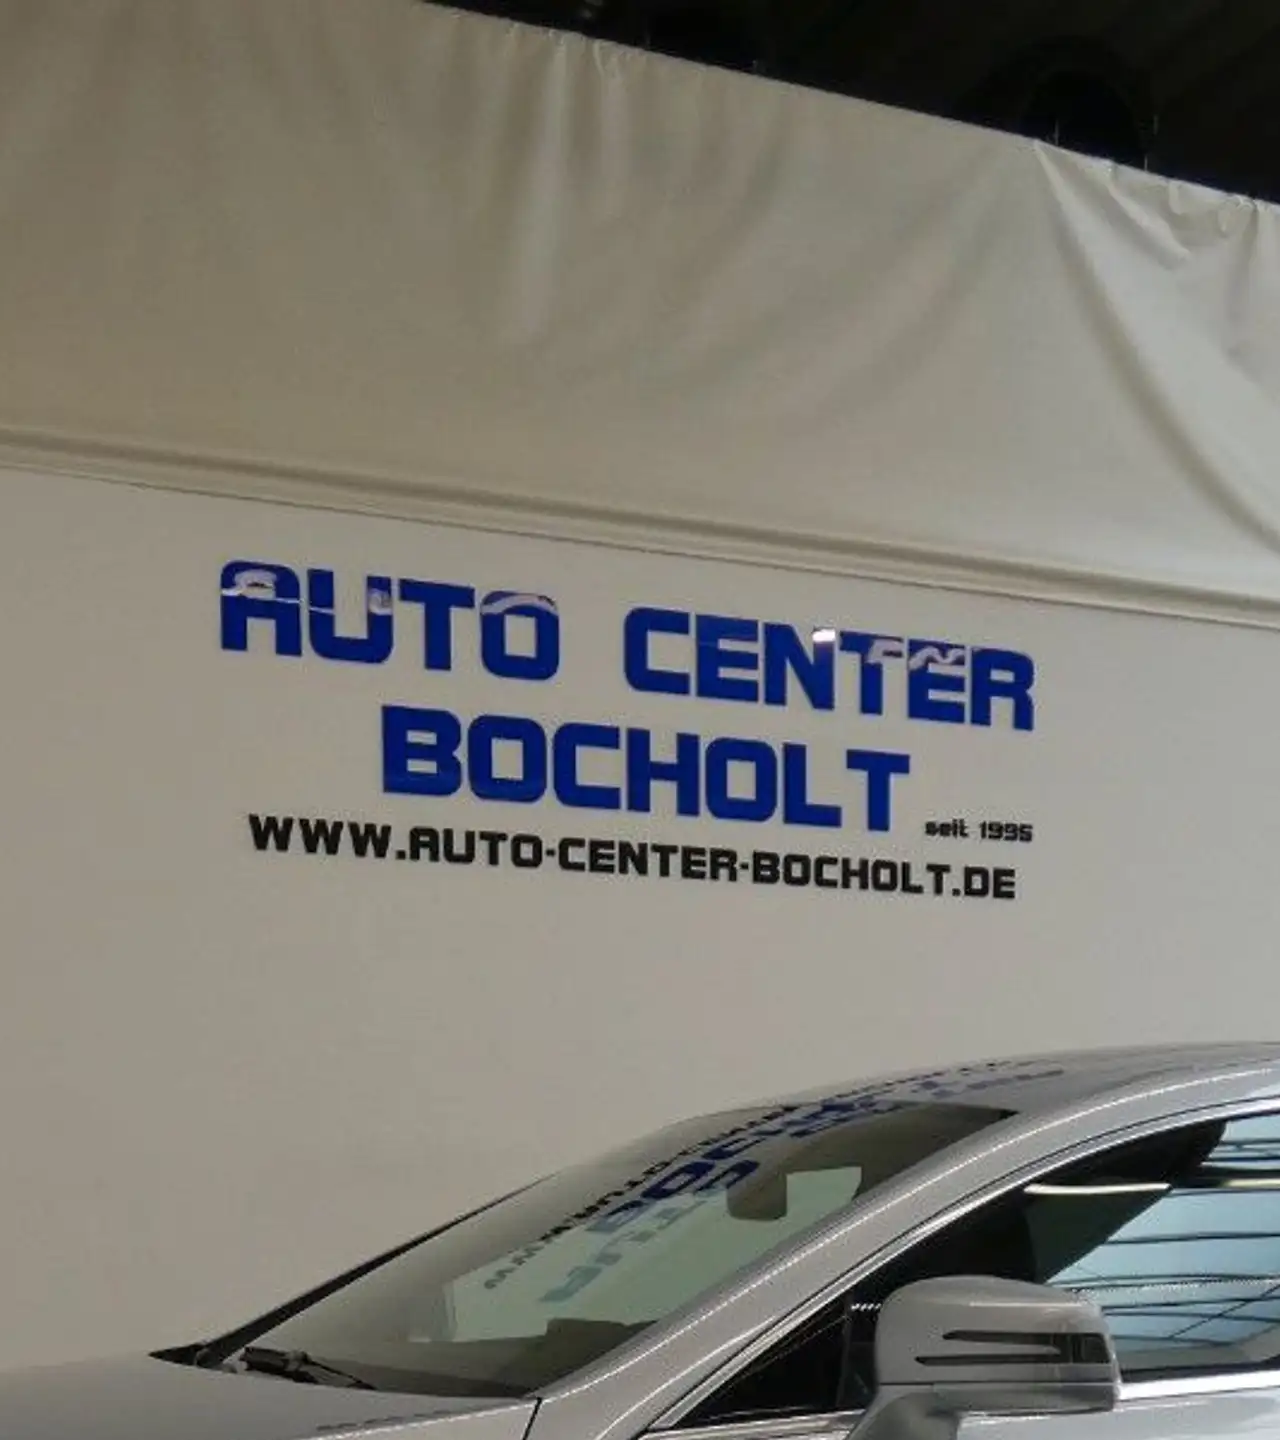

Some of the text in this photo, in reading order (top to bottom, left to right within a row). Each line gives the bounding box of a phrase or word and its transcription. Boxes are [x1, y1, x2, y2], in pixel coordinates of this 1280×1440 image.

[220, 562, 1036, 731] AUTO CENTER
[382, 705, 911, 834] BOCHOLT
[924, 818, 970, 838] seit
